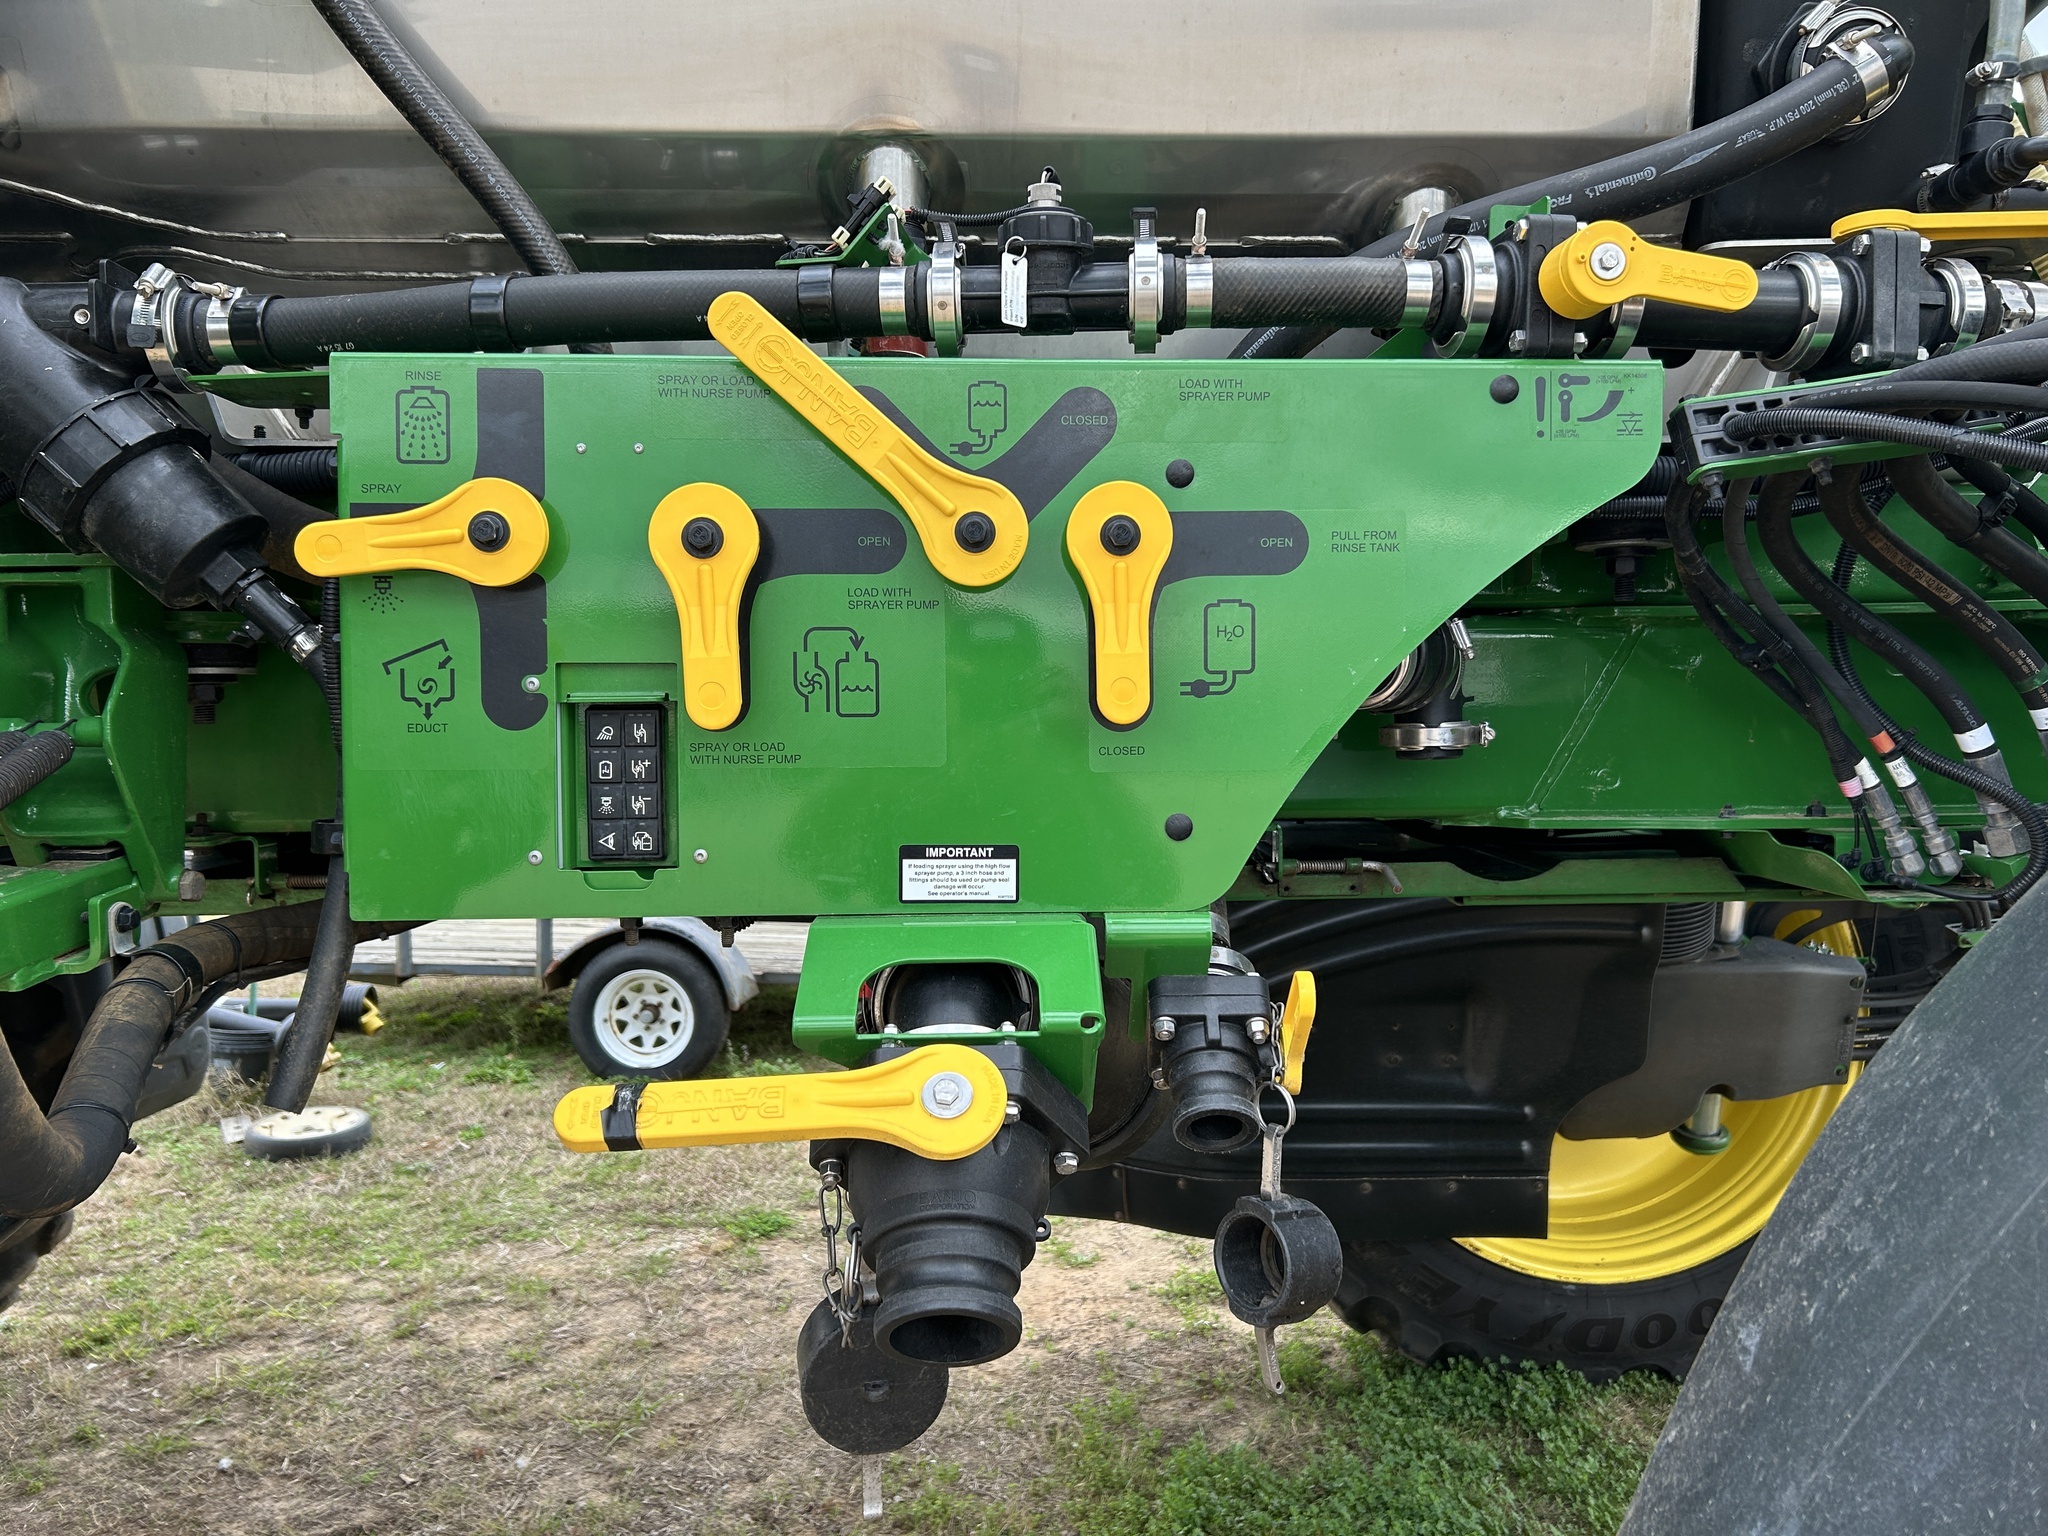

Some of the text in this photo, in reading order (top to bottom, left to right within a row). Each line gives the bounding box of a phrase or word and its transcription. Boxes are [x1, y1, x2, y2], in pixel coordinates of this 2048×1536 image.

[339, 2, 348, 12] in
[346, 11, 367, 37] Made
[378, 51, 396, 71] Bar]
[1813, 77, 1851, 106] (38.1mm)
[412, 92, 427, 109] PSI
[1799, 100, 1816, 115] 200
[427, 107, 444, 125] 200
[1786, 109, 1801, 124] PSI
[1765, 116, 1787, 131] W.P.
[1595, 166, 1657, 196] Continental
[495, 184, 511, 202] 200
[534, 234, 545, 247] Ag
[1658, 263, 1752, 303] BANJO
[725, 309, 743, 332] OPEN
[729, 310, 756, 341] CLOSED
[1241, 326, 1286, 359] ntinental
[405, 370, 442, 381] RINSE
[657, 375, 755, 387] SPRAY OR LOAD
[1178, 378, 1243, 389] LOAD WITH
[657, 388, 771, 400] WITH NURSE PUMP
[752, 329, 879, 451] BANJO
[1178, 391, 1271, 402] SPRAYER PUMP
[1060, 415, 1109, 426] CLOSED
[361, 483, 403, 494] SPRAY
[857, 536, 892, 547] OPEN
[1260, 537, 1294, 548] OPEN
[1331, 531, 1398, 542] PULL FROM
[1331, 543, 1401, 554] RINSE TANK
[847, 588, 912, 598] LOAD WITH
[847, 600, 940, 611] SPRAYER PUMP
[1886, 637, 1908, 655] ITALY
[1953, 698, 1977, 728] ALFAGO
[407, 723, 449, 734] EDUCT
[689, 742, 786, 753] SPRAY OR LOAD
[1098, 746, 1146, 757] CLOSED
[689, 754, 802, 765] WITH NURSE PUMP
[925, 847, 994, 858] IMPORTANT
[917, 1189, 978, 1205] BANJO
[919, 1202, 976, 1212] CORPORATION
